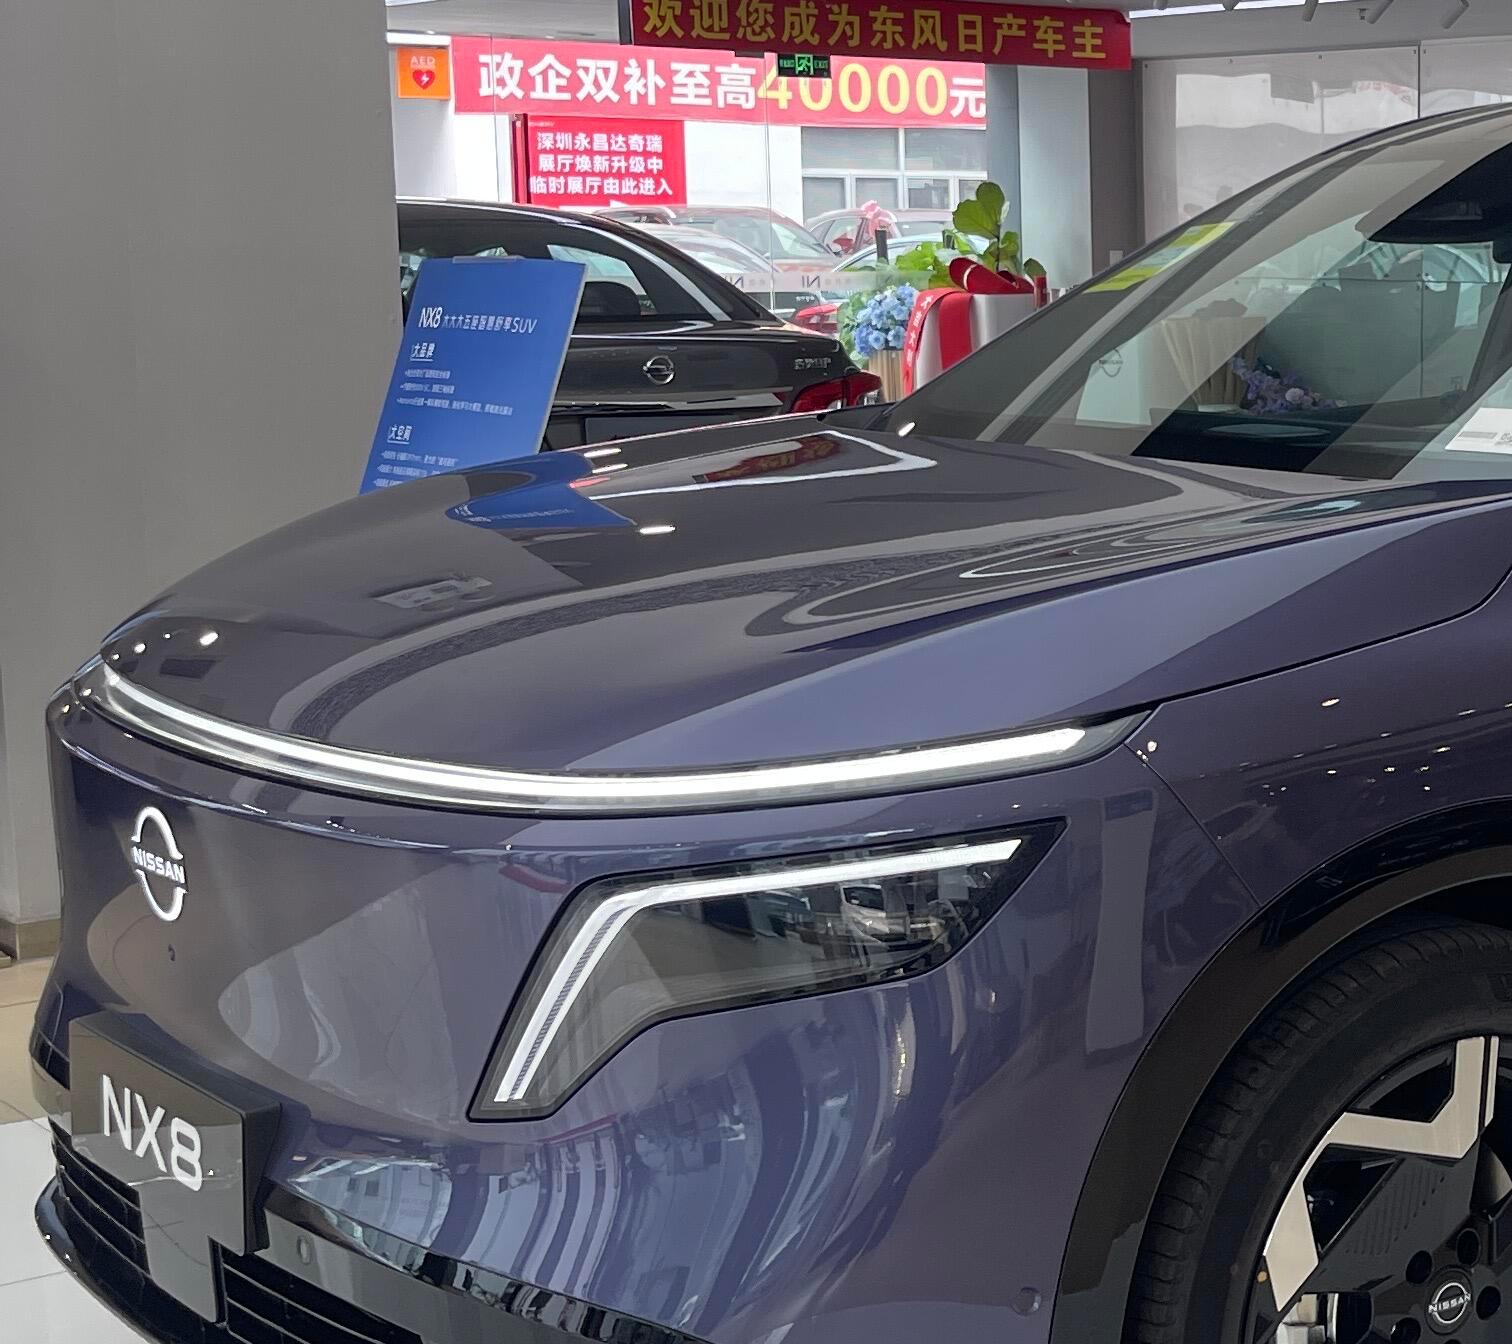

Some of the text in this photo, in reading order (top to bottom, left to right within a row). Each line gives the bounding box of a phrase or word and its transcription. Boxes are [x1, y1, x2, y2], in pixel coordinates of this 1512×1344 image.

[410, 55, 436, 65] AED
[478, 52, 986, 119] 政企双补至高40000元
[537, 132, 663, 153] 深圳永昌达奇瑞
[538, 154, 664, 174] 展厅焕新升级中
[529, 176, 673, 196] 临时展厅由此进入
[418, 306, 443, 329] NX8
[132, 845, 186, 884] NISSAN
[102, 1074, 203, 1192] NX8
[1428, 1293, 1471, 1314] NISSAN
